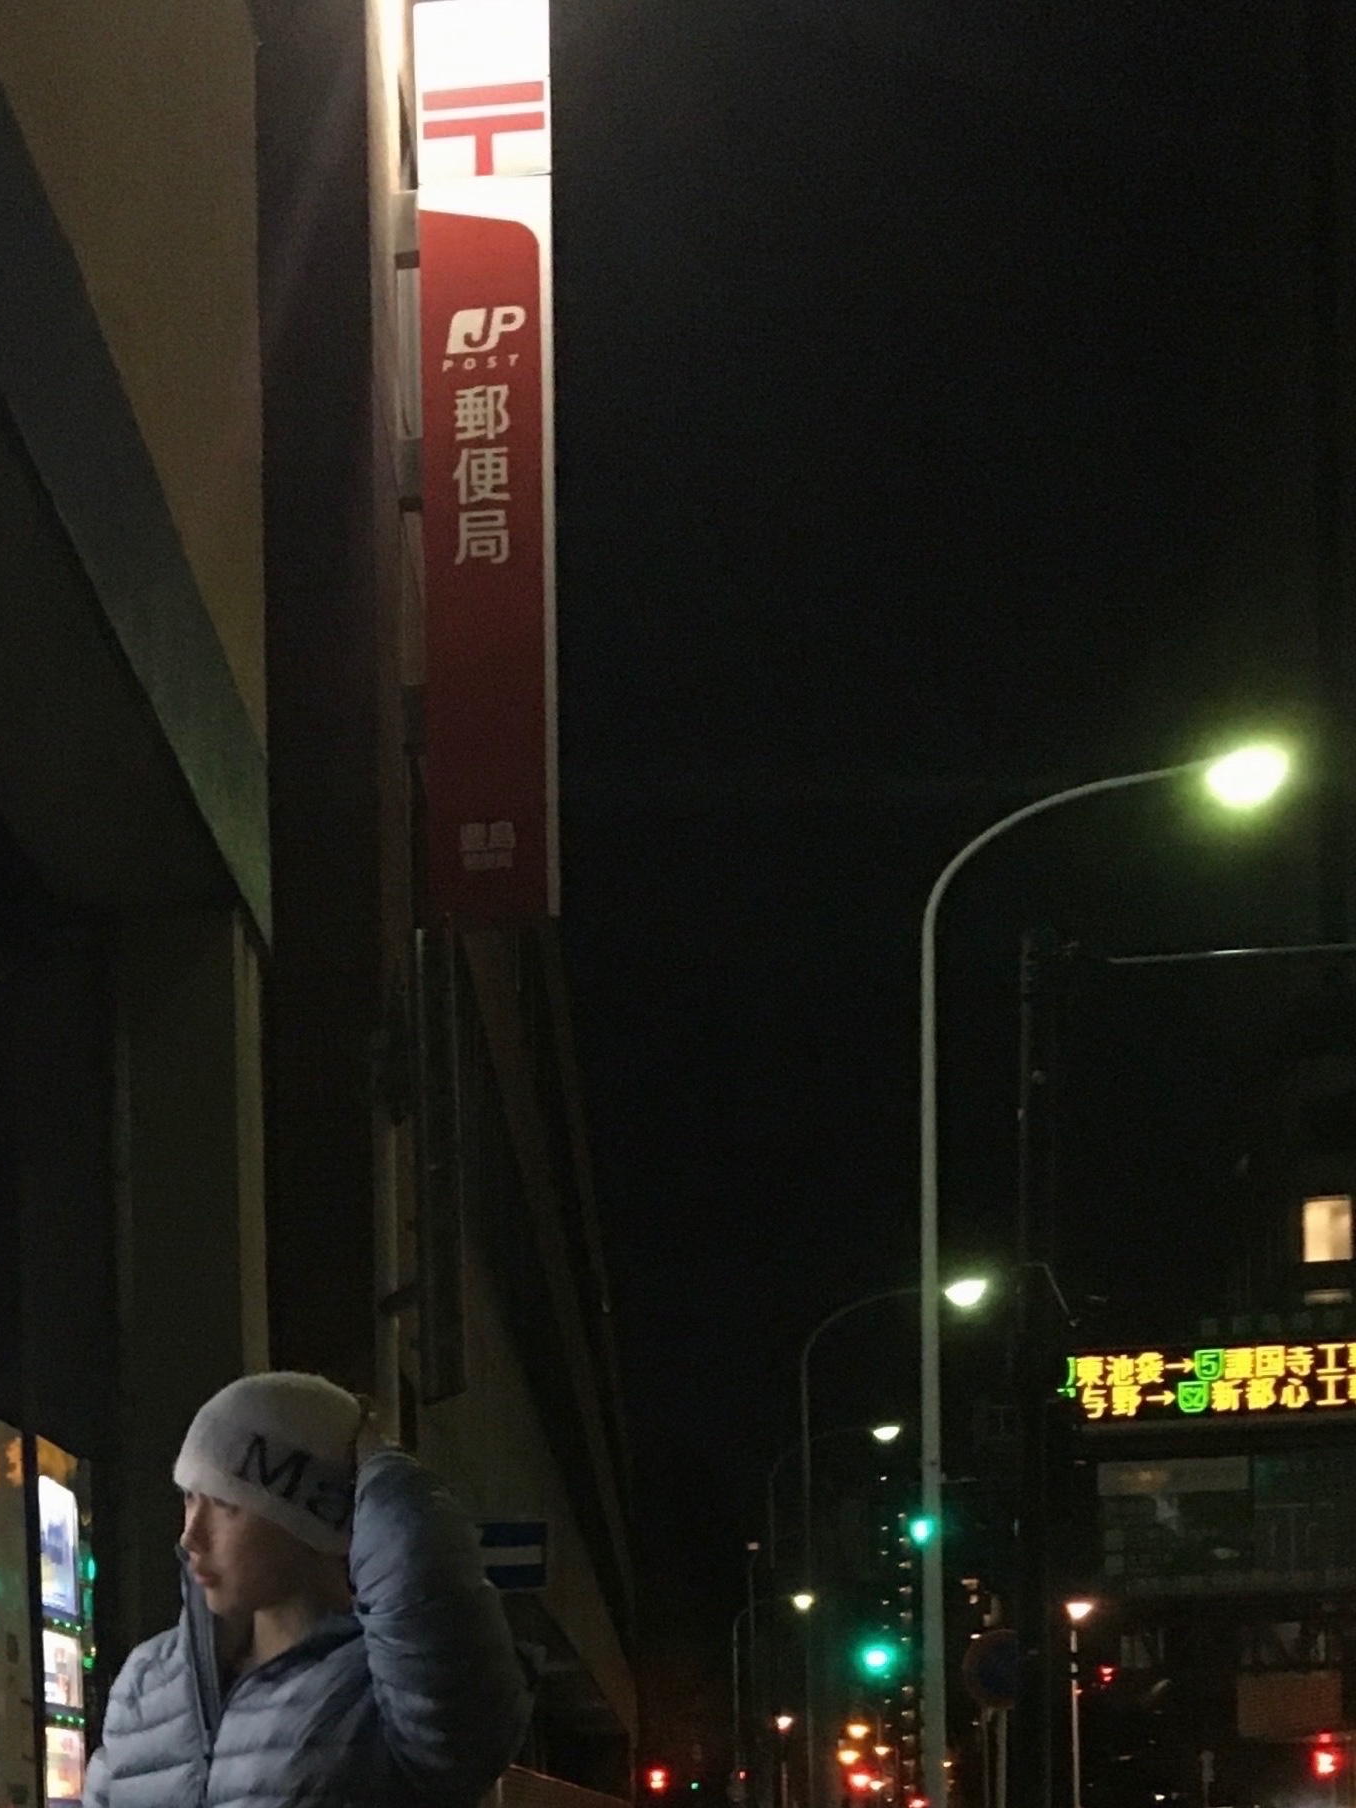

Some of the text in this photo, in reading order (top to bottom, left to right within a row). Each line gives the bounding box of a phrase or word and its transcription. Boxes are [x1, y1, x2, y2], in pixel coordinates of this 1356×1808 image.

[446, 305, 526, 354] JP
[442, 353, 520, 372] POST
[453, 385, 511, 566] 郵便局
[1076, 1352, 1165, 1387] 東池袋
[1225, 1343, 1356, 1379] 護国寺工
[1081, 1385, 1142, 1419] 与野
[1211, 1374, 1356, 1411] 新都心工
